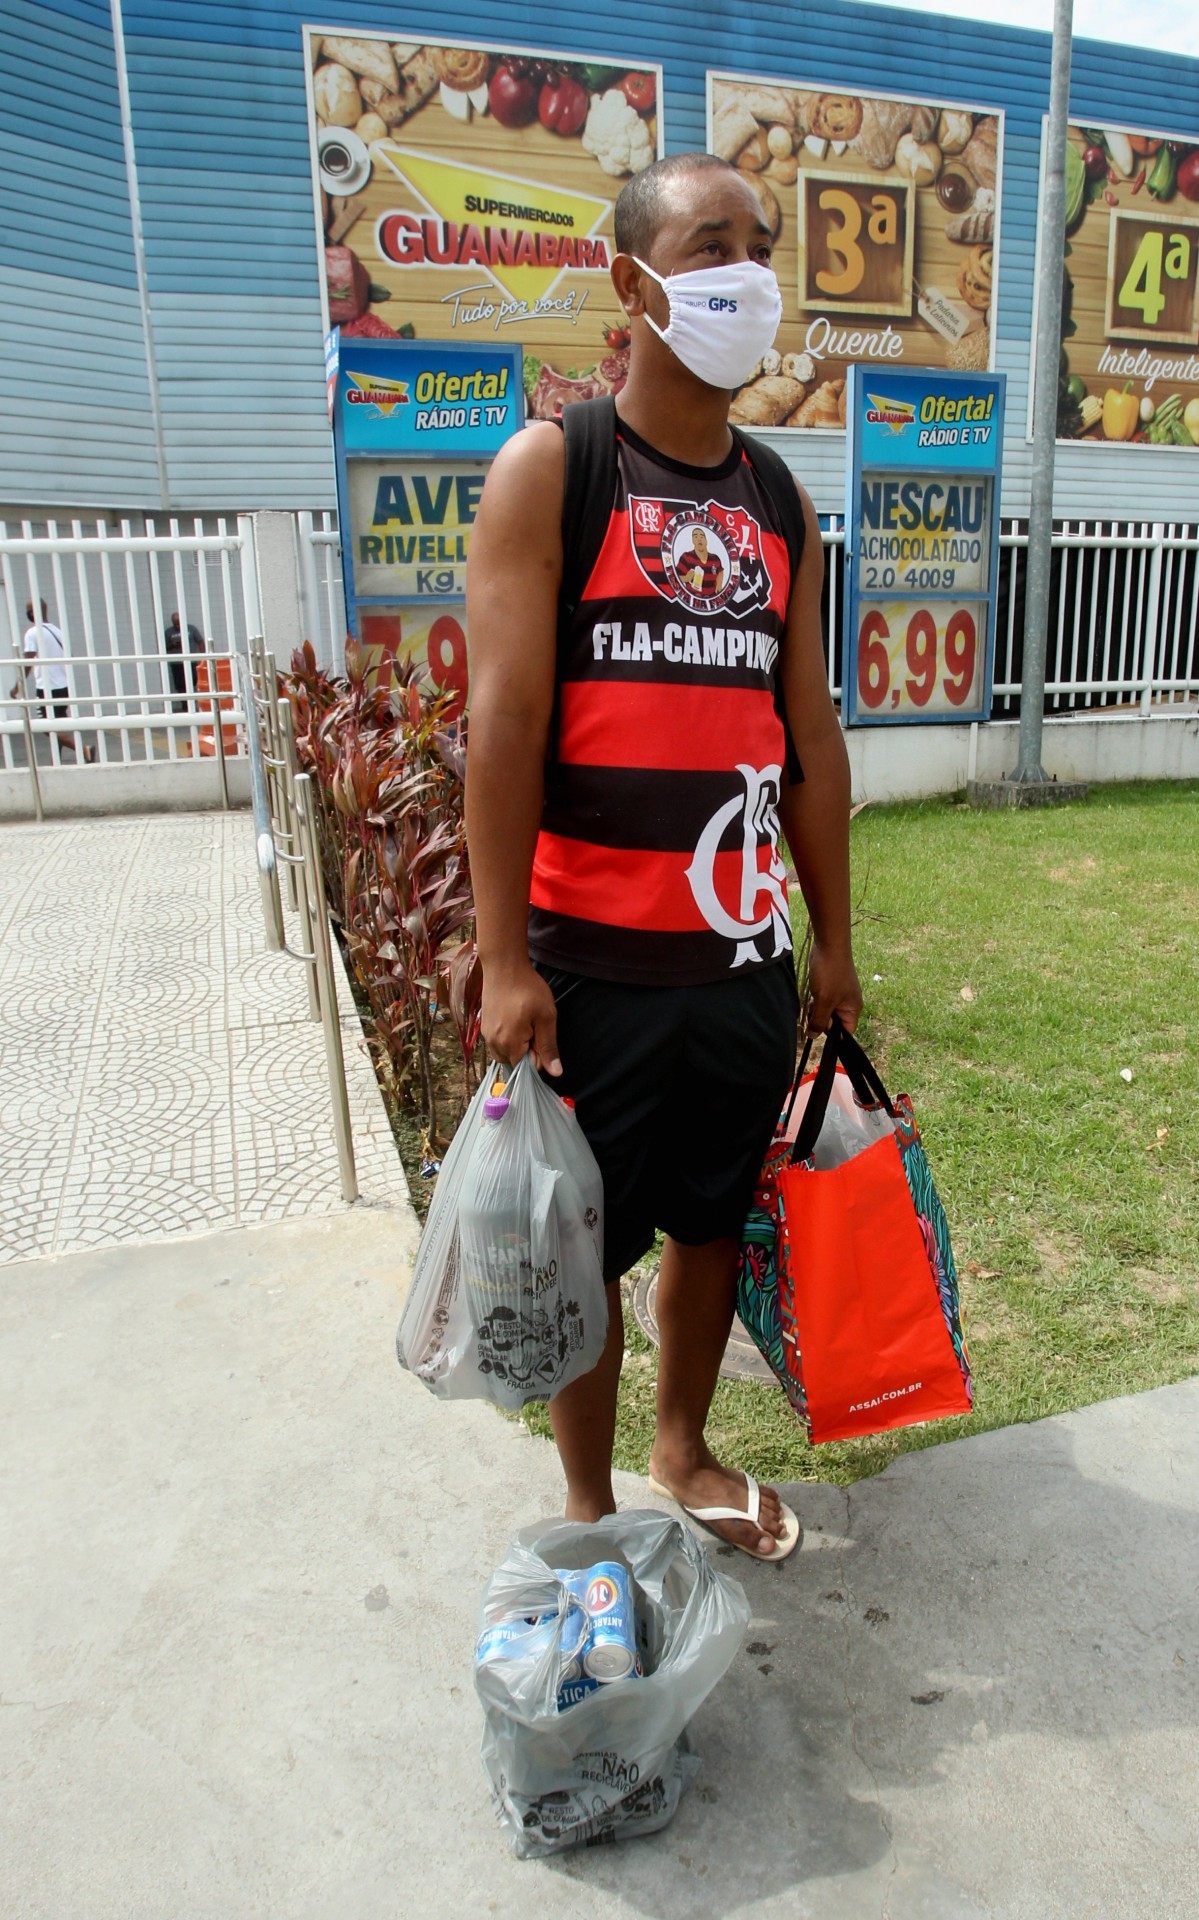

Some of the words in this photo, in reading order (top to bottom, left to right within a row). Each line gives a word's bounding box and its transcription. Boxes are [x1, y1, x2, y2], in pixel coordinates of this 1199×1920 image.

[464, 194, 575, 228] SUPERMERCADOS
[379, 214, 610, 270] GUANABARA
[441, 283, 495, 328] Tudo
[494, 298, 530, 331] por
[708, 297, 738, 314] GPS
[804, 317, 904, 360] Quente
[415, 368, 508, 404] Oferta!
[415, 406, 466, 431] RÁDIO
[469, 406, 480, 427] E
[485, 406, 507, 426] TV
[920, 393, 994, 424] Oferta!
[918, 426, 957, 447] RÁDIO
[961, 427, 970, 444] E
[974, 426, 991, 444] TV
[860, 481, 984, 534] NESCAU
[859, 536, 982, 564] ACHOCOLATADO
[865, 567, 896, 589] 2.0
[857, 608, 976, 710] 6,99
[507, 1379, 536, 1390] FRALDA
